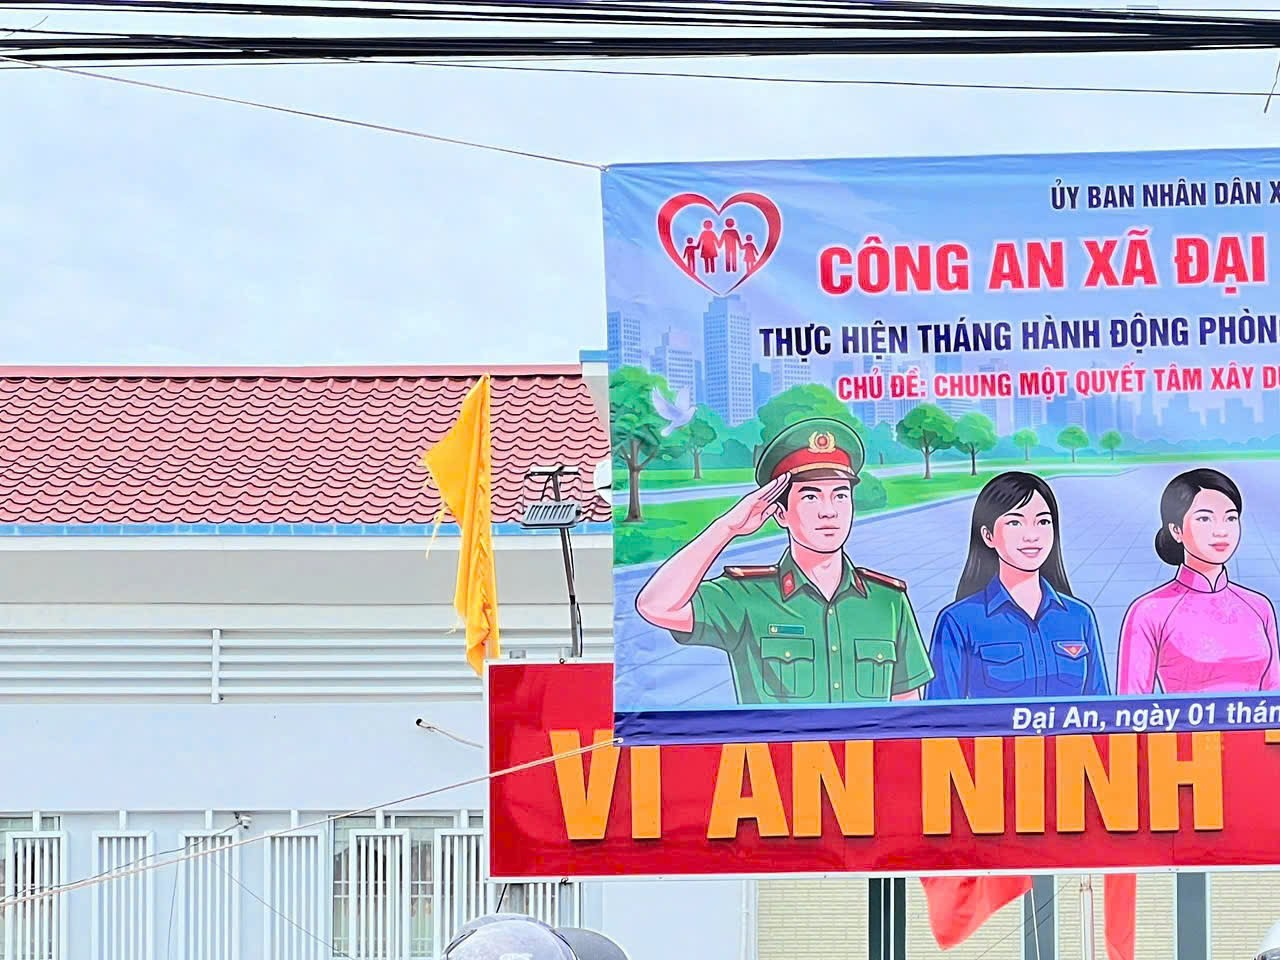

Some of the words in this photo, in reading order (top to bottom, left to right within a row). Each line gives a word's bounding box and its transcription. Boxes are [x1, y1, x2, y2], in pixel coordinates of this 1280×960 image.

[1051, 179, 1079, 210] ỦY
[1088, 184, 1134, 209] BAN
[1142, 177, 1206, 208] NHÂN
[1214, 176, 1261, 206] DÂN
[820, 235, 969, 295] CÔNG
[988, 240, 1064, 290] AN
[1083, 229, 1157, 287] XÃ
[1174, 236, 1265, 294] ĐẠI
[759, 323, 831, 362] THỰC
[842, 321, 908, 359] HIỆN
[917, 316, 1012, 354] THÁNG
[1022, 315, 1100, 351] HÀNH
[1110, 313, 1188, 354] ĐỘNG
[838, 367, 880, 400] CHỦ
[890, 367, 927, 399] ĐỀ:
[934, 373, 1012, 399] CHUNG
[1019, 367, 1065, 400] MỘT
[1076, 363, 1144, 397] QUYẾT
[1153, 363, 1201, 393] TÂM
[1210, 361, 1255, 391] XÂY
[1012, 707, 1055, 737] Đại
[1062, 707, 1107, 732] An,
[1115, 704, 1179, 733] ngày
[1188, 703, 1216, 725] 01
[707, 740, 874, 838] AN
[921, 732, 1223, 836] NINH
